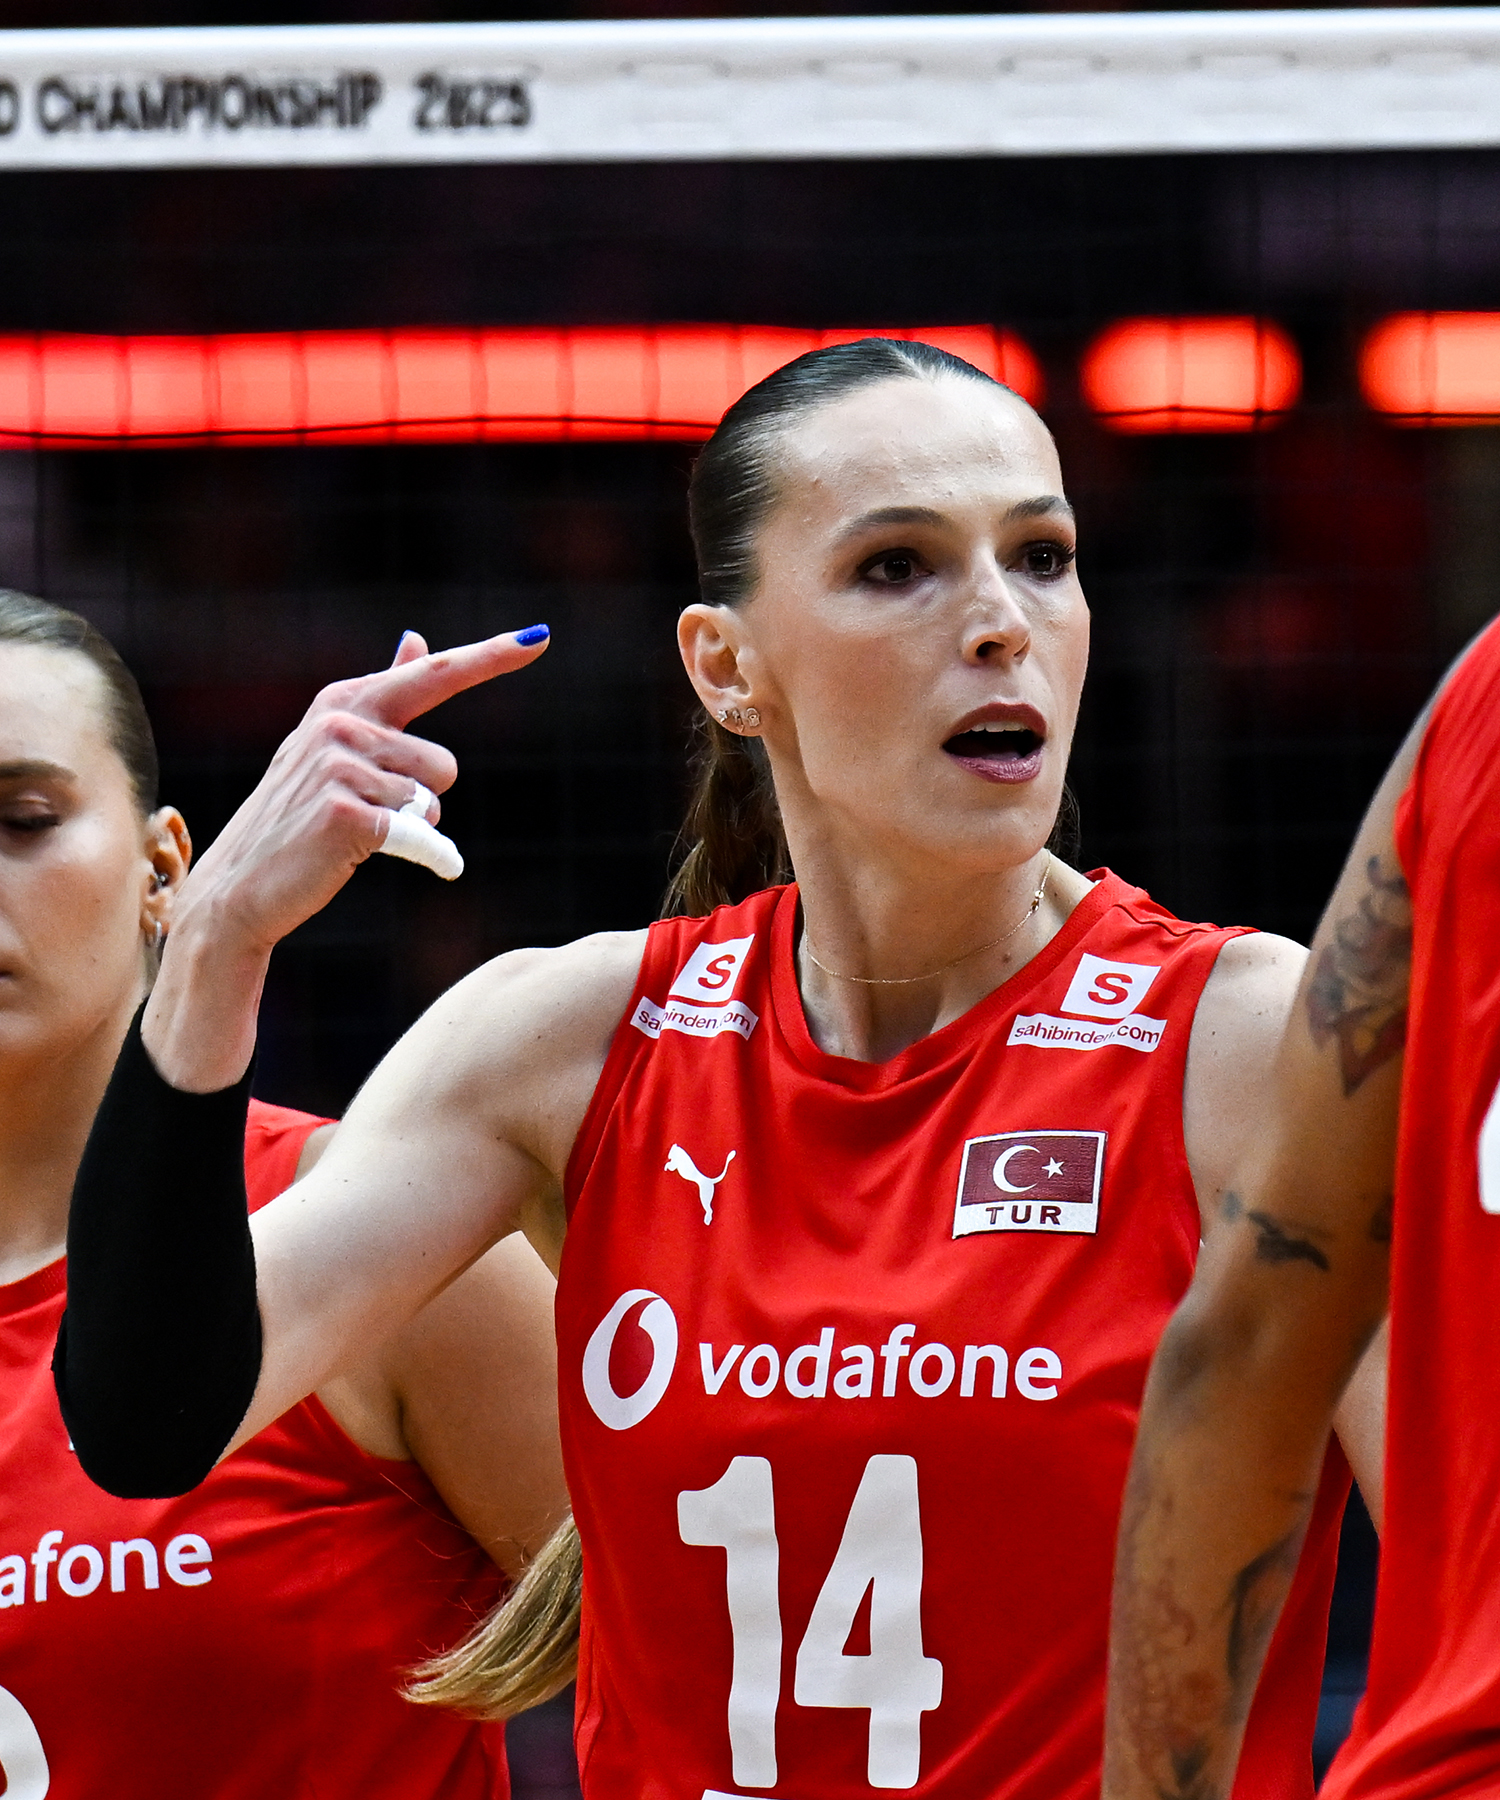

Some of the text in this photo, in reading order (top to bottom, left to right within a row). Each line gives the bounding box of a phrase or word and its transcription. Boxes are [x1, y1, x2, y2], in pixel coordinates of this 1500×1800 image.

[986, 1205, 1061, 1226] TUR
[699, 1323, 1062, 1401] vodafone
[677, 1453, 943, 1789] 14
